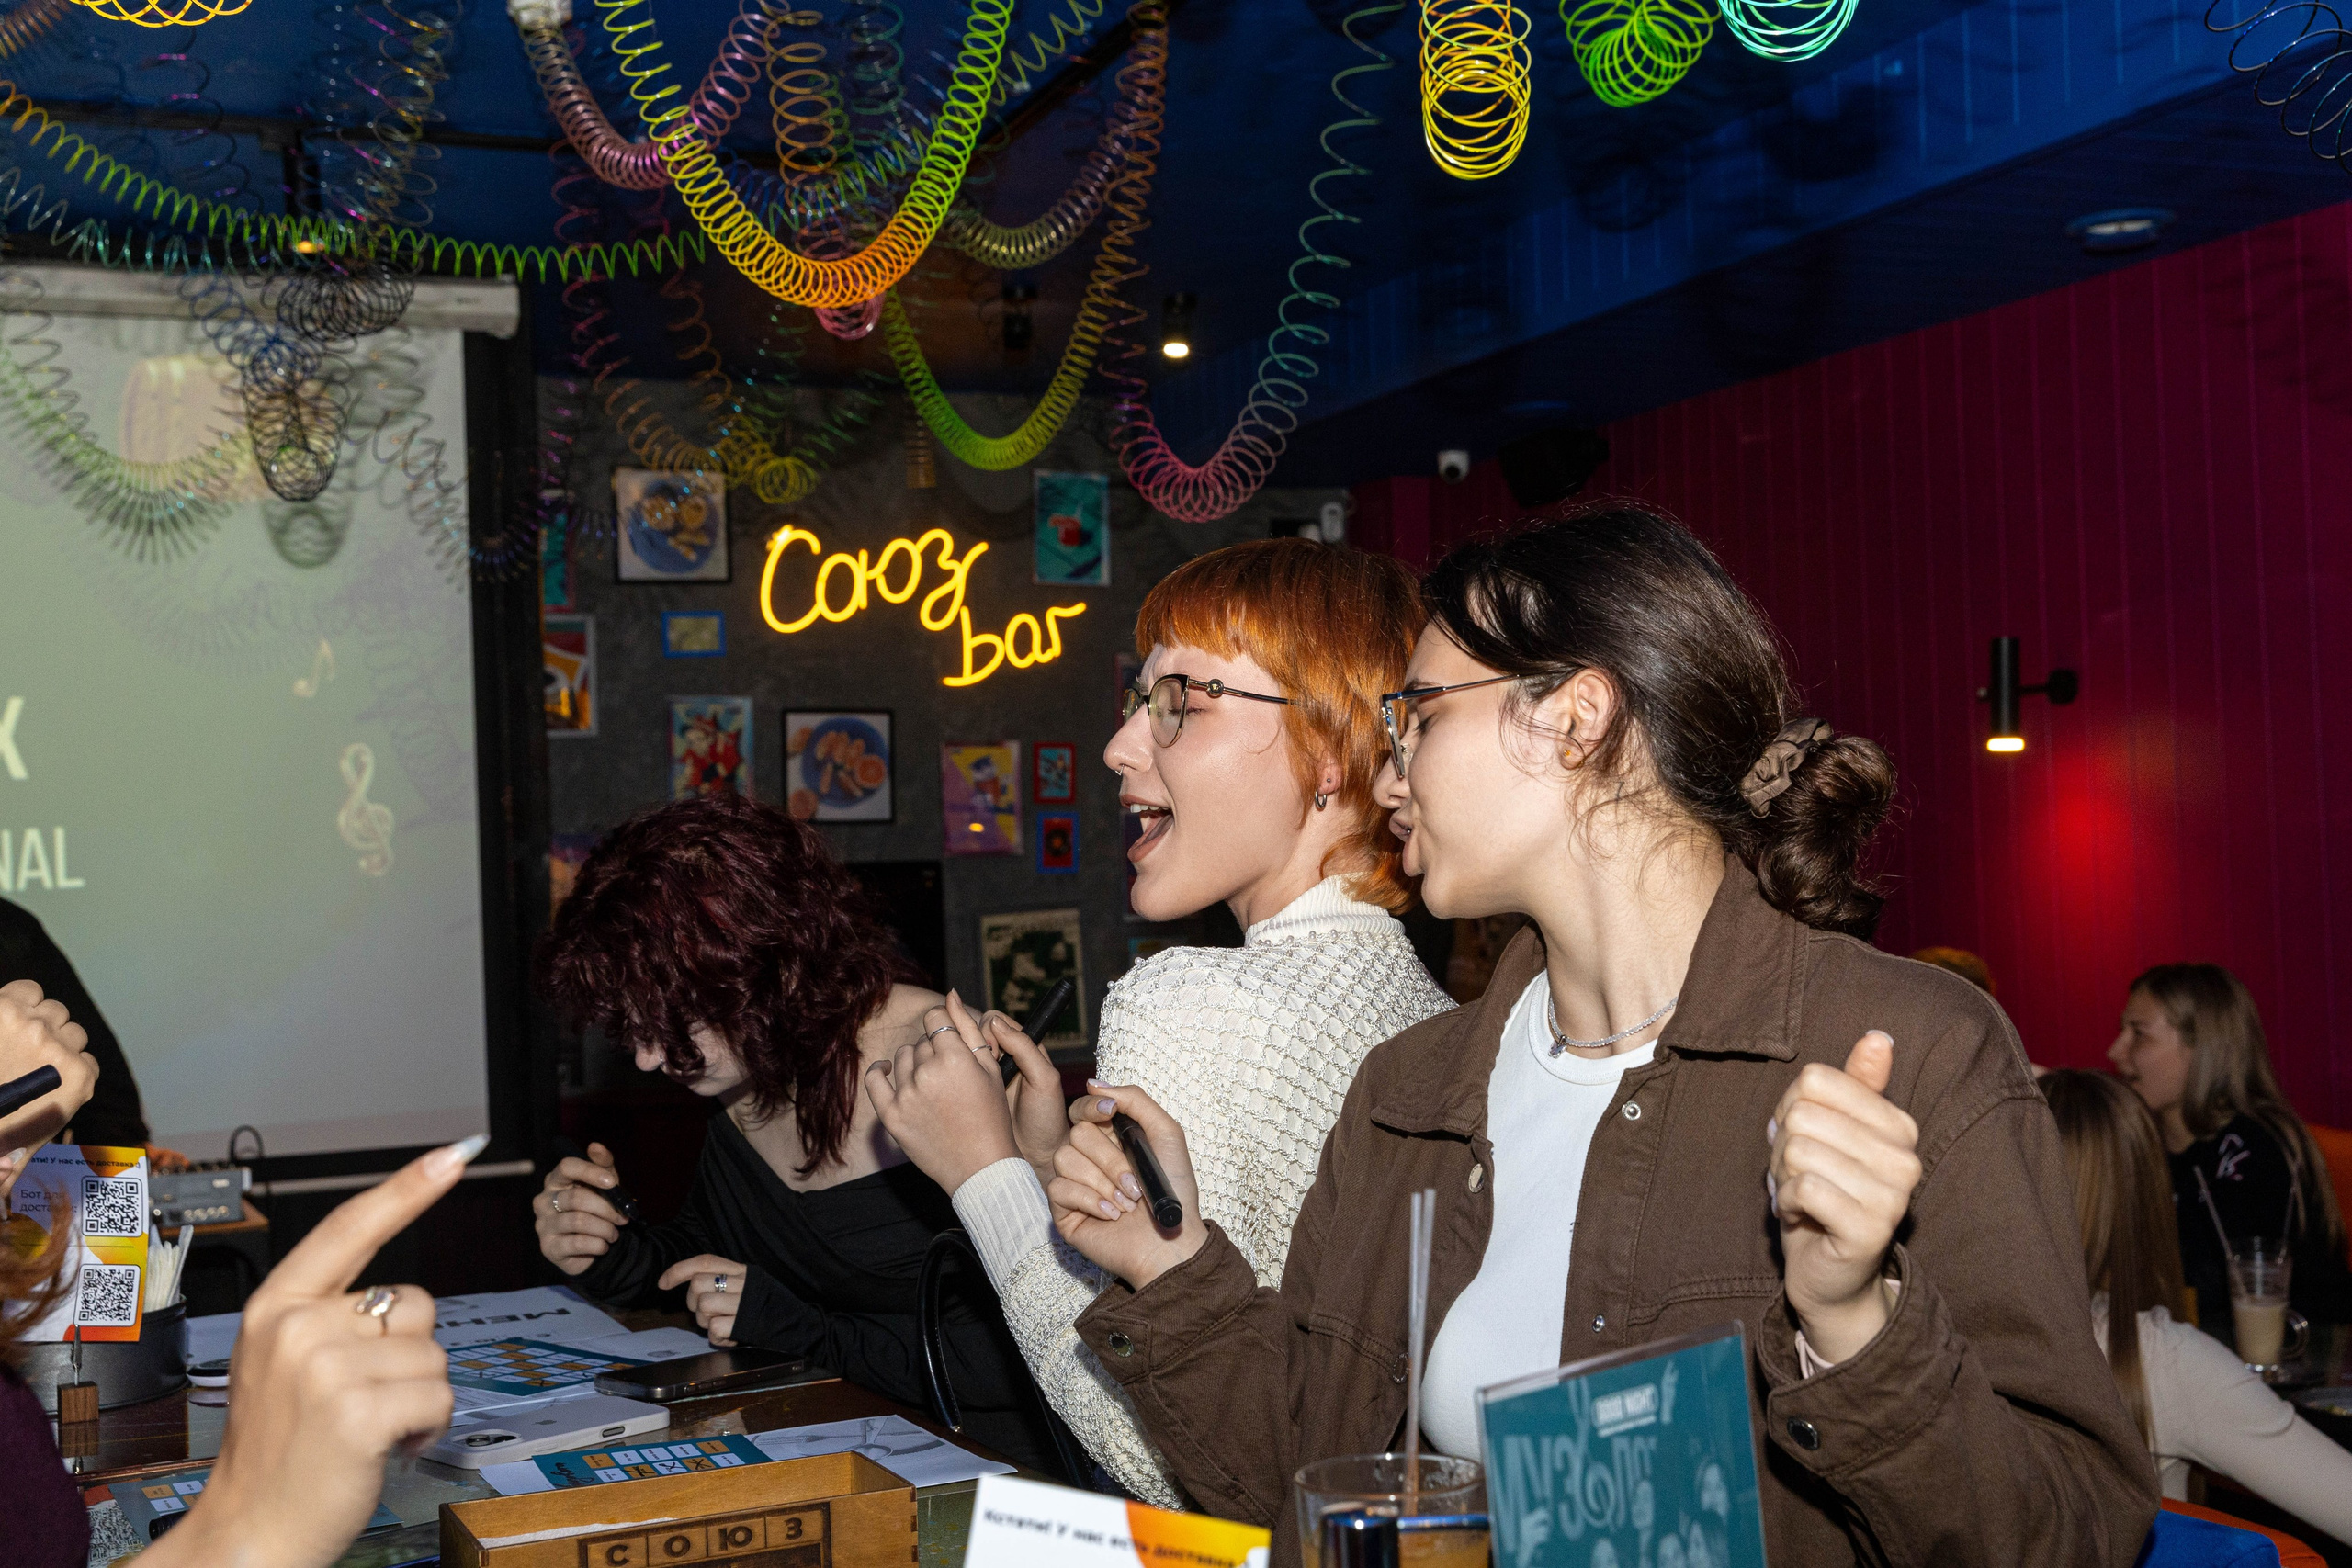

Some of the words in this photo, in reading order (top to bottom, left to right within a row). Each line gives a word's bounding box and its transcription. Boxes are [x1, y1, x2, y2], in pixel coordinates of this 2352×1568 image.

[761, 525, 989, 633] Союз
[943, 602, 1086, 687] bar
[96, 1159, 134, 1168] доставка
[20, 1189, 41, 1199] Бот
